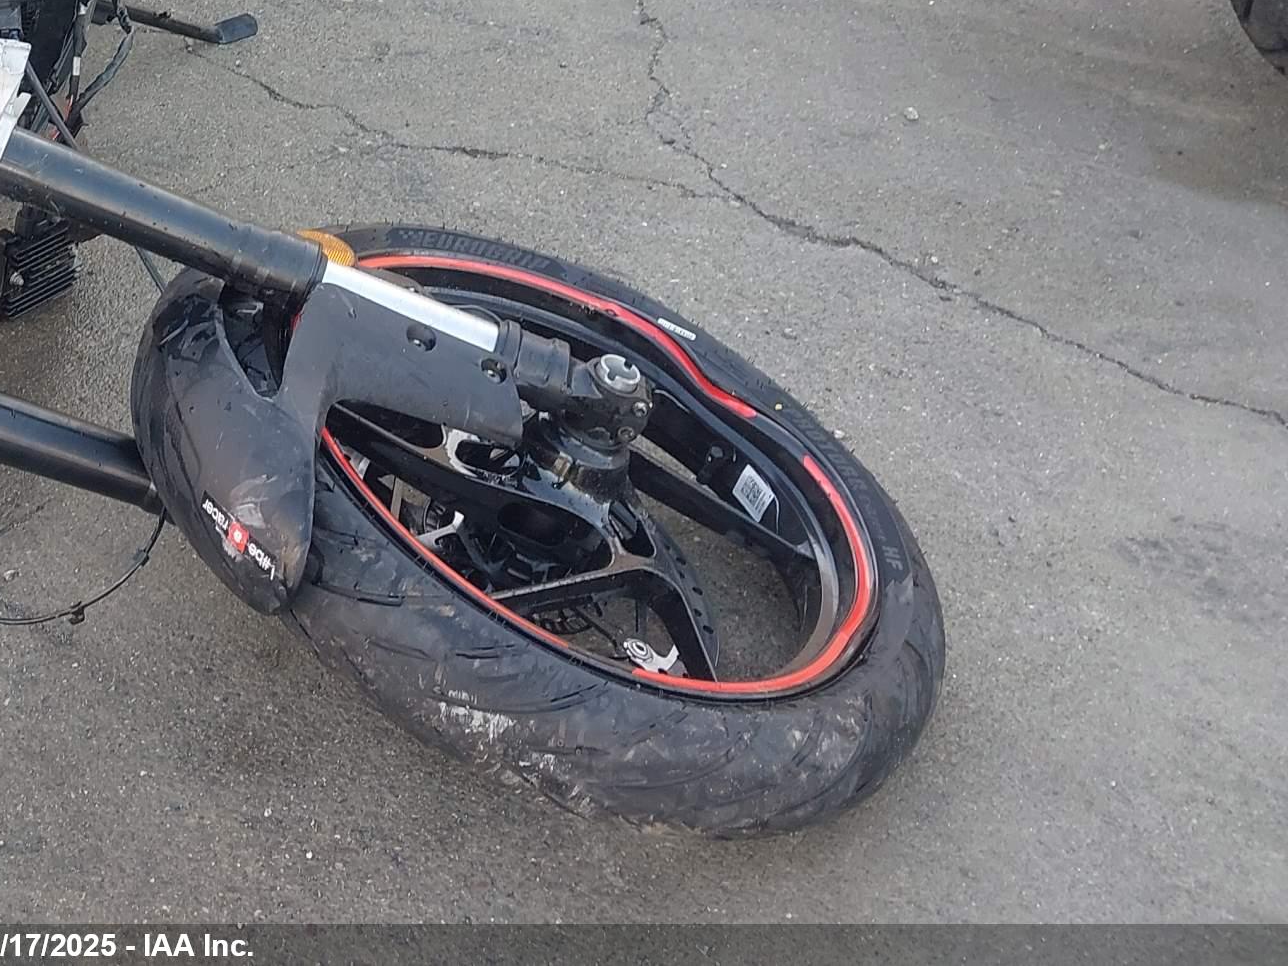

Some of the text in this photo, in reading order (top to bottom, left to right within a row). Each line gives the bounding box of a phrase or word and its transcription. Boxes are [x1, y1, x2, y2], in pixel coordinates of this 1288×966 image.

[423, 232, 551, 269] EUROGRIP
[202, 498, 229, 530] racer
[882, 545, 903, 571] HF
